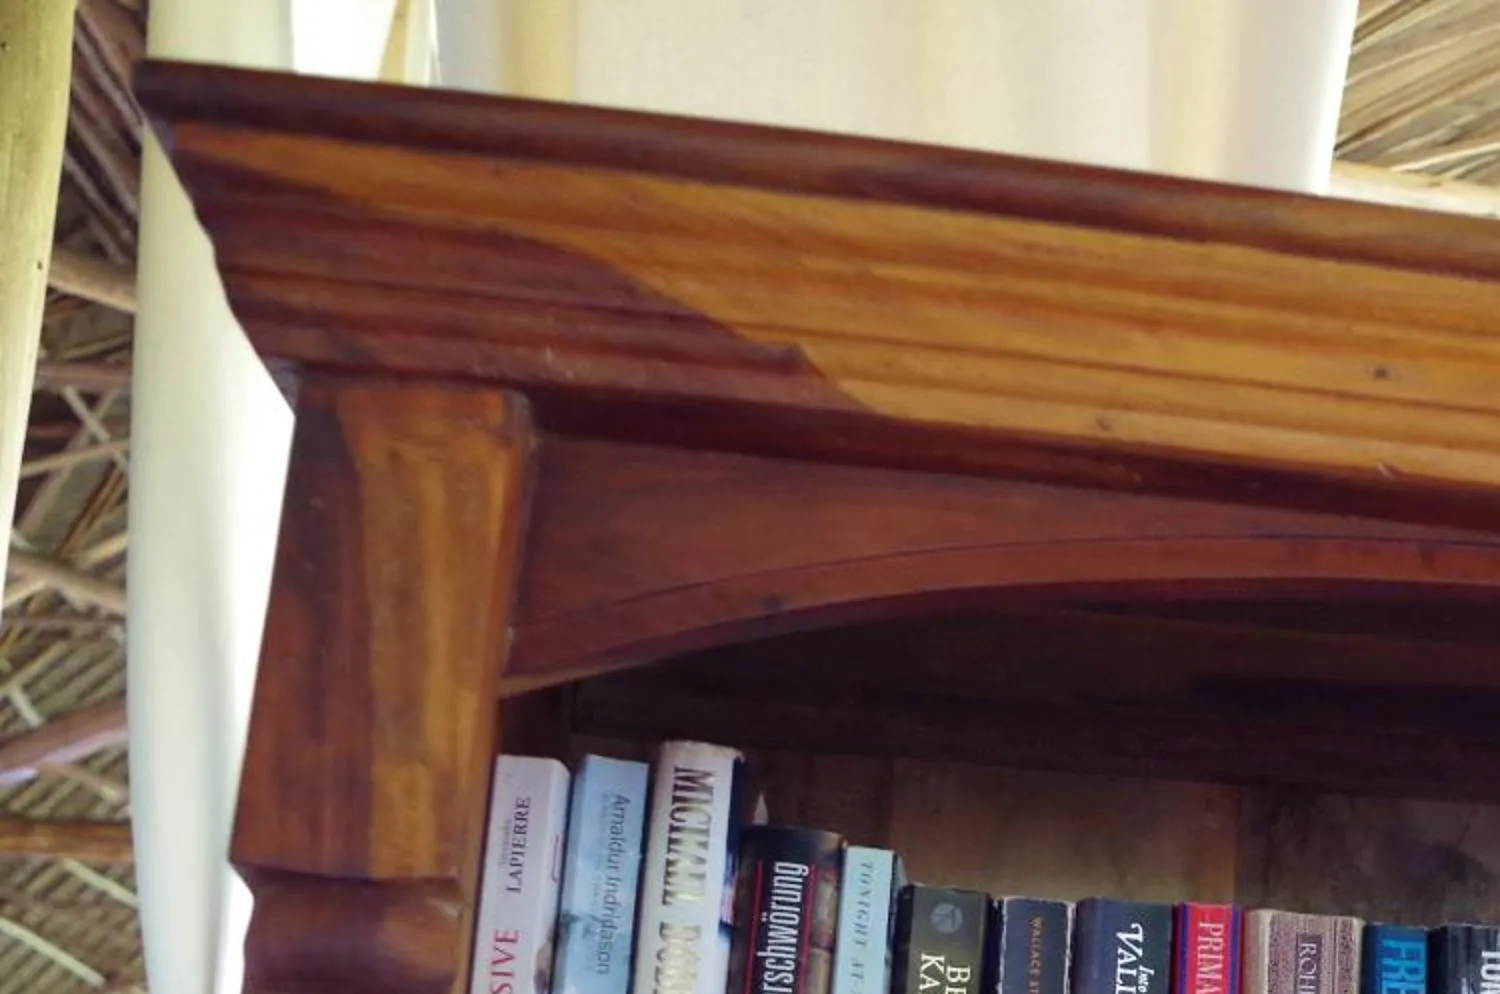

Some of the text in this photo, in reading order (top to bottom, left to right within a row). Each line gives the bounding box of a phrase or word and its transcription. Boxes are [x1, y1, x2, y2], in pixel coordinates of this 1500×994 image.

[505, 796, 531, 894] LAPIERRE
[662, 767, 716, 905] MICHAEL
[854, 861, 873, 948] TONIGHT
